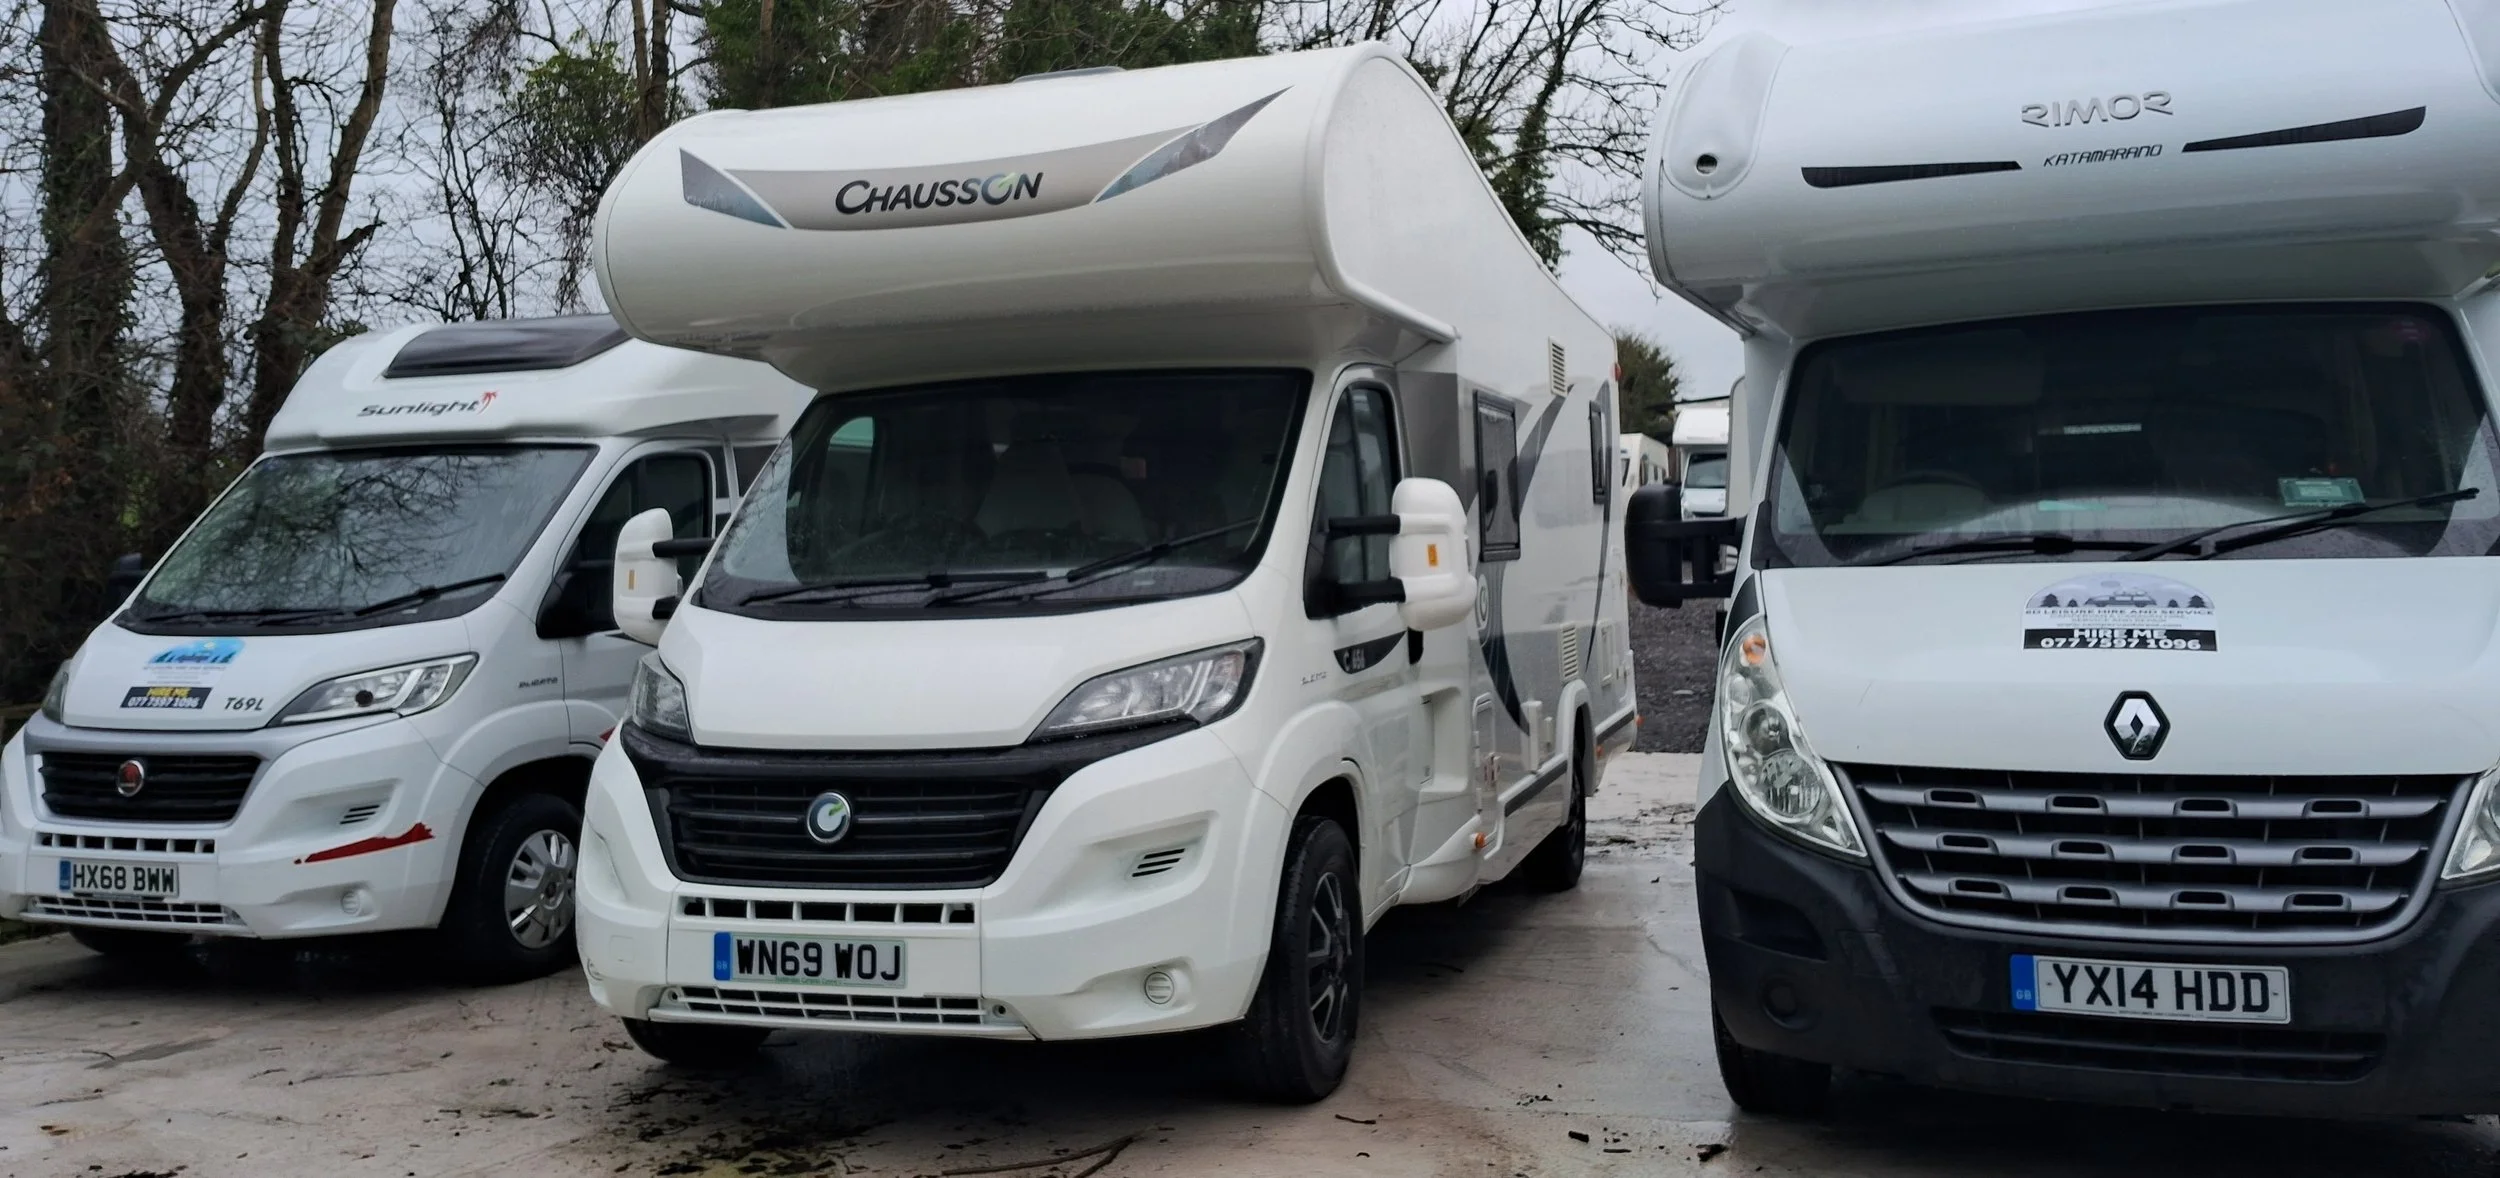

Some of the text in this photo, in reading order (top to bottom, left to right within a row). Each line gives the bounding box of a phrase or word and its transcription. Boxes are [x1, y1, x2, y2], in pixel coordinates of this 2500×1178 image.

[2022, 91, 2173, 127] RIMOR
[2044, 144, 2163, 167] KATAMARANO
[356, 400, 480, 417] Sunlight
[2040, 638, 2081, 648] 077
[2147, 639, 2202, 650] 1096
[2073, 629, 2167, 639] HIRE ME
[224, 698, 264, 711] T69L
[73, 864, 174, 893] HX68 BWW
[736, 939, 901, 981] WN69 WOJ
[2016, 990, 2032, 1000] GB
[2052, 963, 2269, 1013] YX14 HDD
